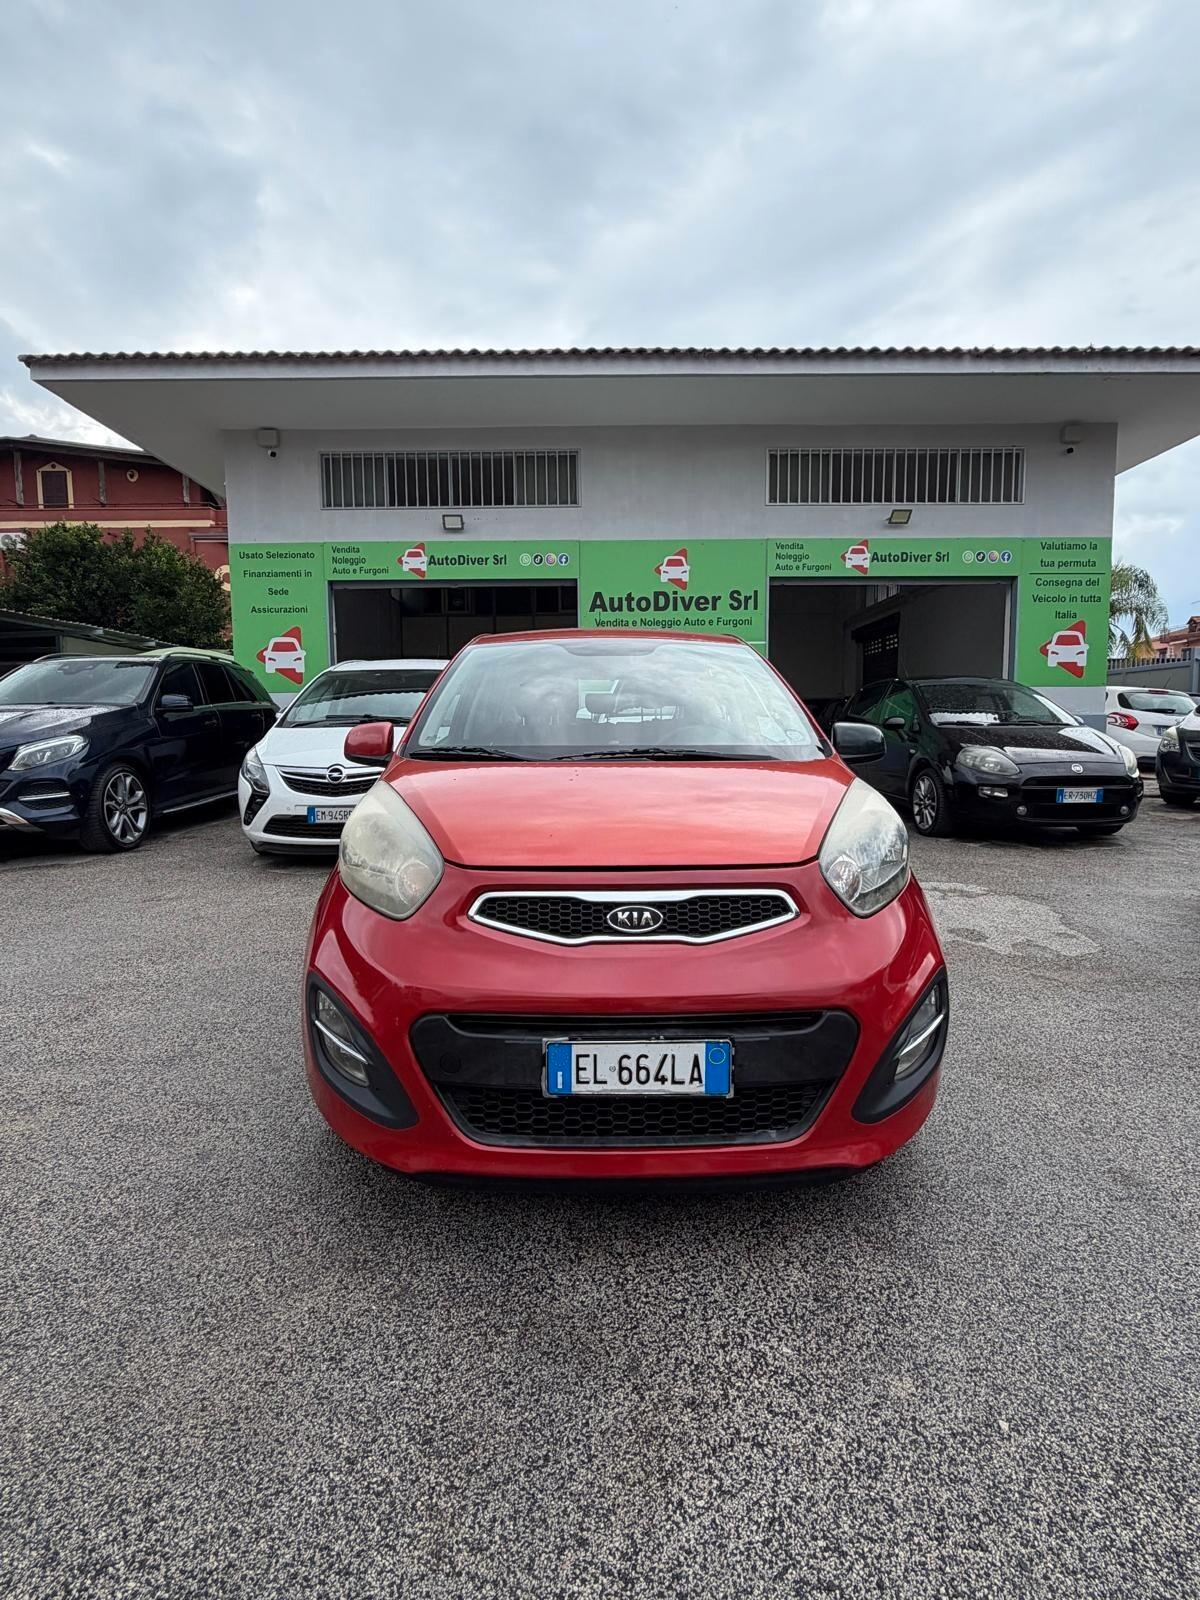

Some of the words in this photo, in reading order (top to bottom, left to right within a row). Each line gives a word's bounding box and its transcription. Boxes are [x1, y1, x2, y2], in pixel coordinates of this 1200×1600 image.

[332, 546, 360, 554] Vendita
[774, 542, 804, 550] Vendita
[1040, 542, 1087, 550] Valutiamo
[1090, 542, 1098, 550] la
[332, 556, 366, 565] Noleggio
[428, 555, 489, 566] AutoDiver
[492, 554, 507, 565] Srl
[775, 552, 810, 560] Noleggio
[871, 552, 932, 562] AutoDiver
[935, 552, 950, 562] Srl
[775, 563, 794, 571] Auto
[802, 563, 832, 572] Furgoni
[1040, 559, 1054, 568] tua
[1058, 559, 1096, 569] permuta
[244, 570, 302, 578] Finanziamenti
[304, 569, 312, 578] in
[332, 566, 350, 574] Auto
[360, 566, 389, 576] Furgoni
[1036, 578, 1083, 588] Consegna
[1086, 578, 1100, 586] del
[268, 588, 288, 596] Sede
[589, 591, 722, 612] AutoDiver
[728, 590, 758, 610] Srl
[1032, 594, 1066, 602] Veicolo
[1069, 594, 1078, 602] in
[1080, 594, 1102, 602] tutta
[250, 606, 308, 614] Assicurazioni
[1055, 610, 1077, 618] Italia
[594, 618, 630, 628] Vendita
[640, 618, 682, 628] Noleggio
[684, 617, 706, 626] Auto
[716, 616, 752, 627] Furgoni
[617, 912, 654, 926] KIA
[575, 1054, 608, 1084] EL
[618, 1054, 703, 1086] 664LA
